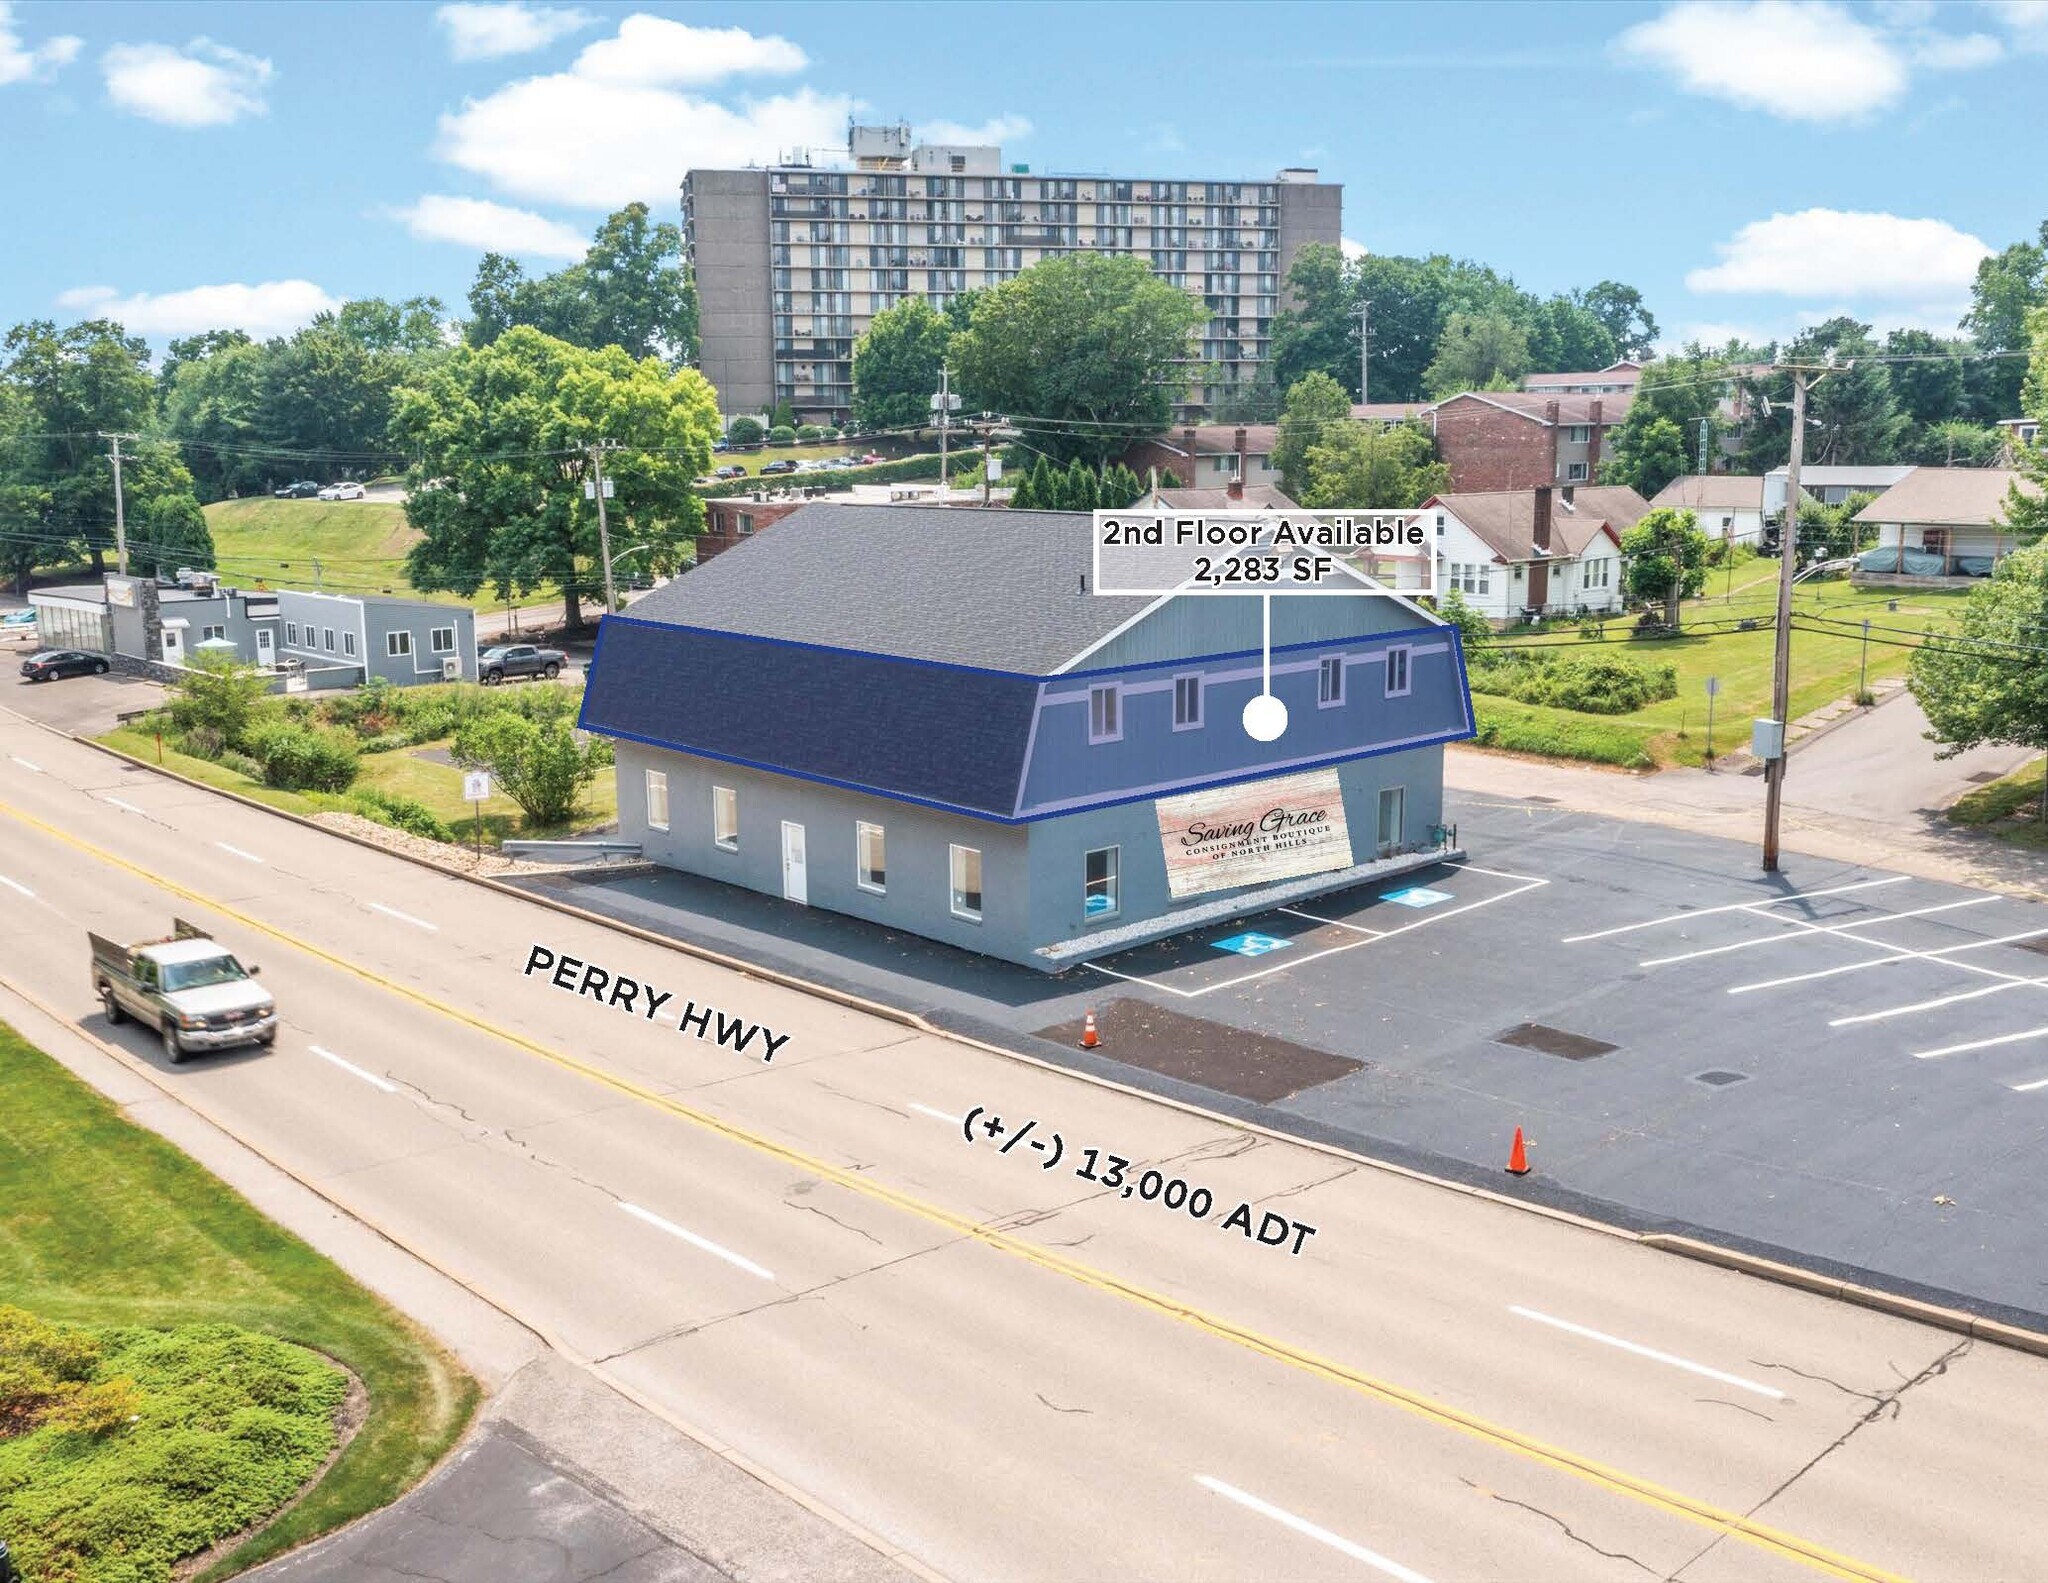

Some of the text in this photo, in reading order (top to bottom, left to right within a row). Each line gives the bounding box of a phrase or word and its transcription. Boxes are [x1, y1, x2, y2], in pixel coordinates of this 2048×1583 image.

[1181, 808, 1328, 847] Saving Grace
[1185, 825, 1332, 856] CONSIGNMENT BOUTIQUE
[1212, 838, 1308, 861] OF NORTH HILLS
